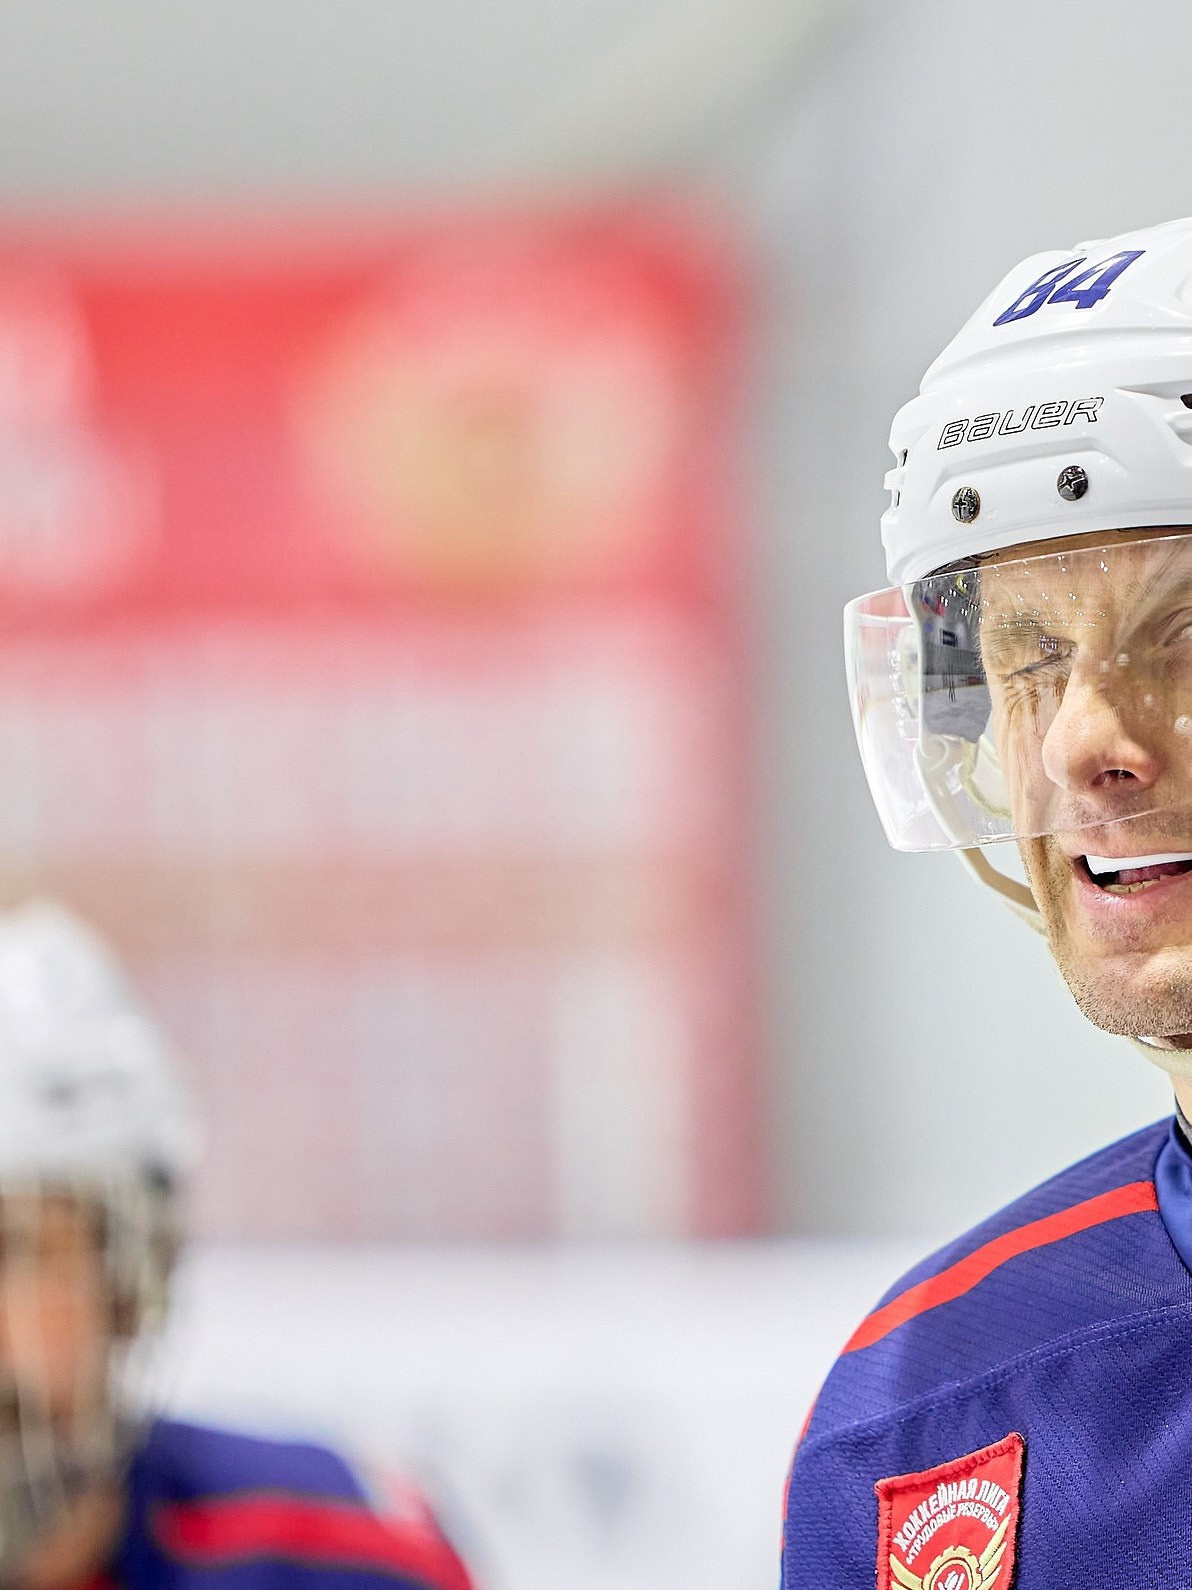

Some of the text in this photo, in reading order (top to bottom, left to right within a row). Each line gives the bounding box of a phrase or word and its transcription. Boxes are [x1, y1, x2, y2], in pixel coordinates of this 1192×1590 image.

[992, 249, 1147, 327] 84
[937, 396, 1105, 451] BAUER
[891, 1477, 1011, 1553] ХОККЕЙНАЯ ЛИГА
